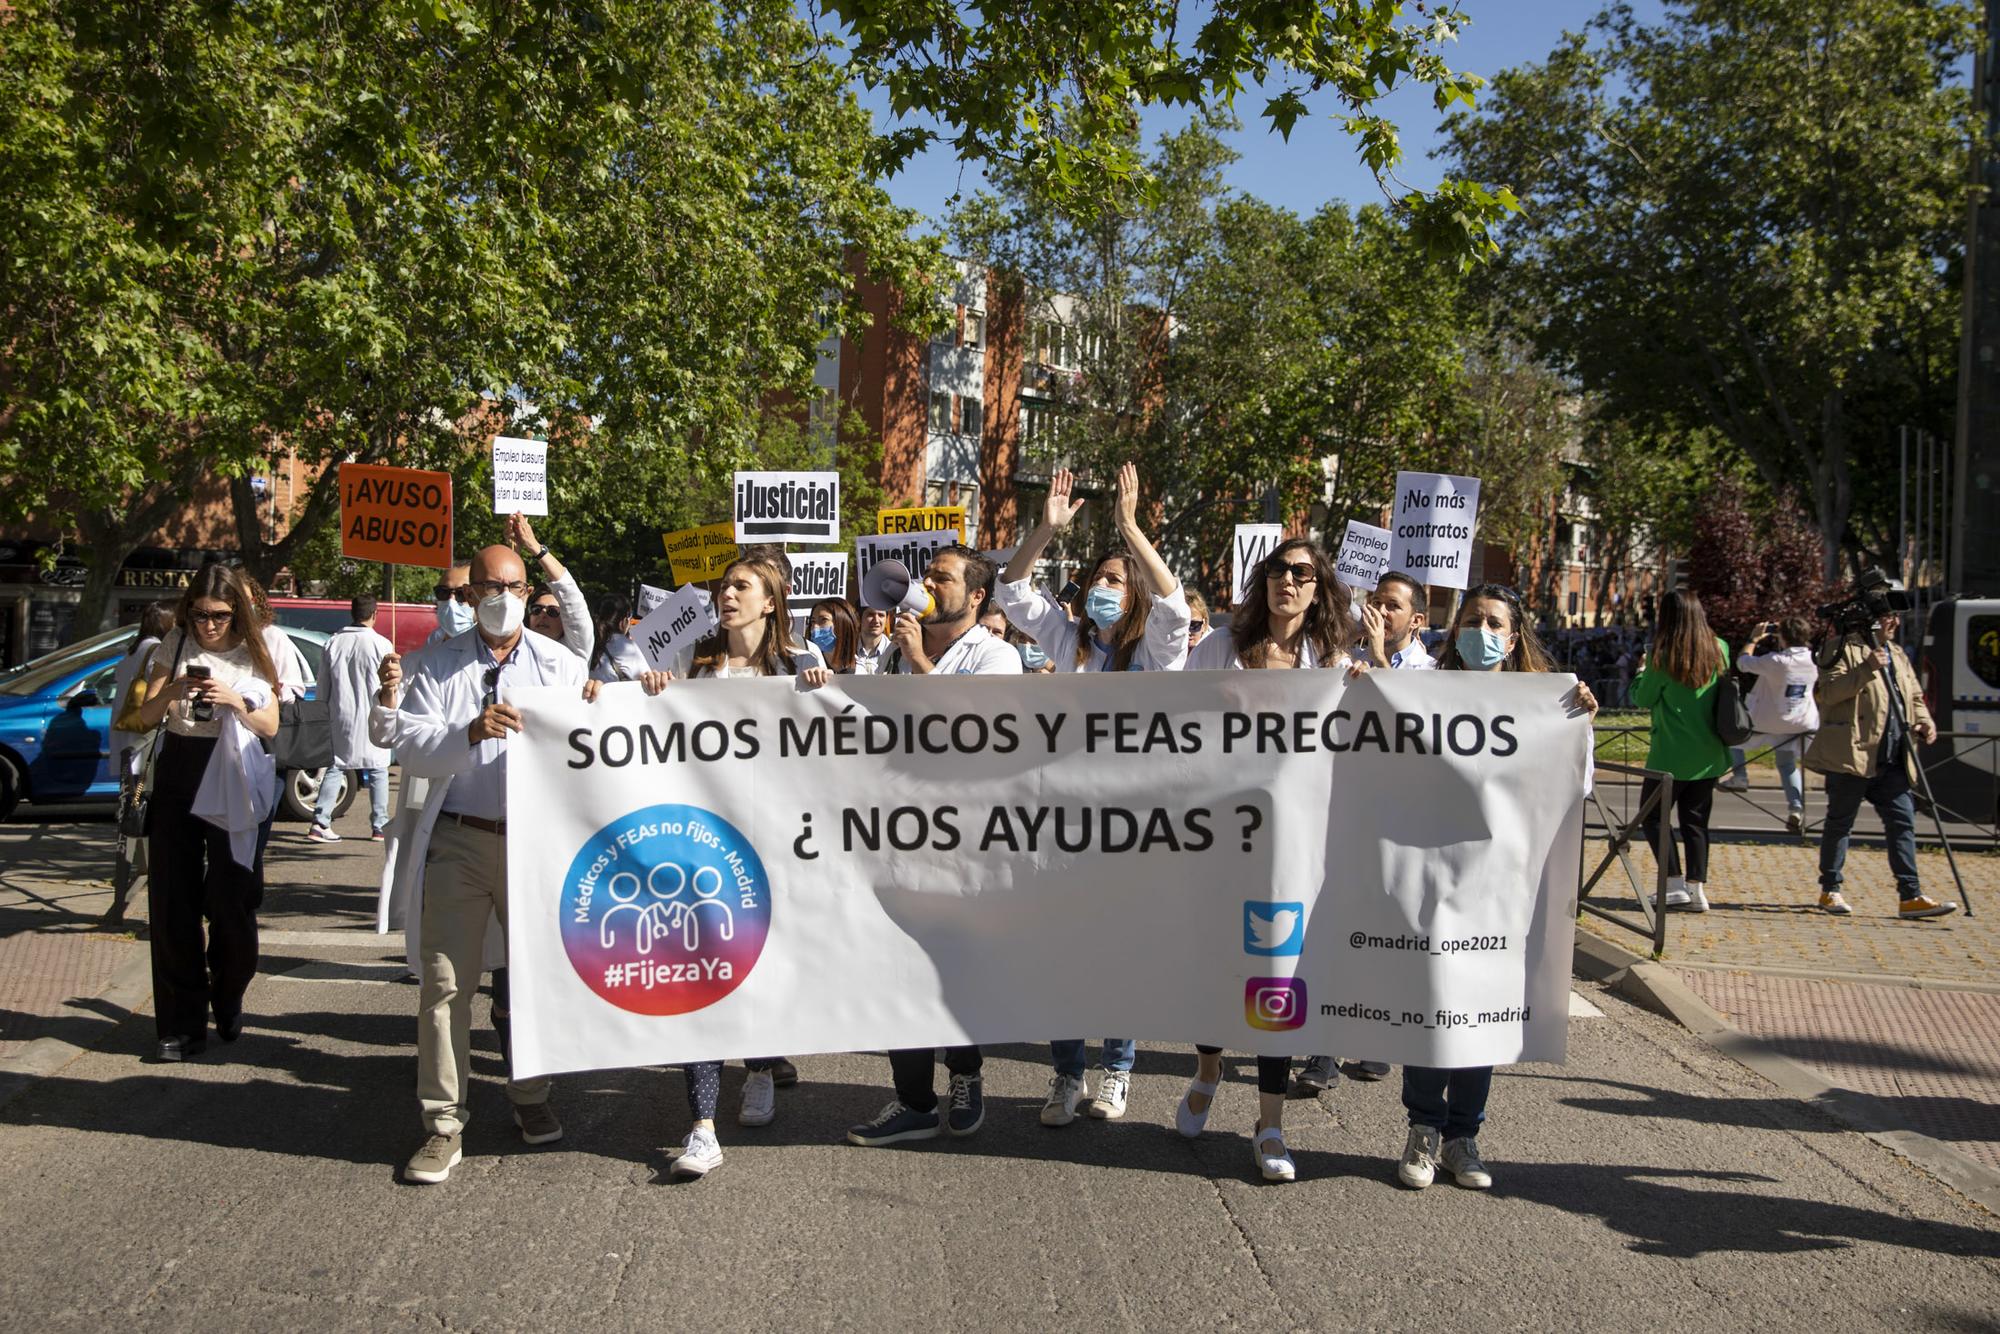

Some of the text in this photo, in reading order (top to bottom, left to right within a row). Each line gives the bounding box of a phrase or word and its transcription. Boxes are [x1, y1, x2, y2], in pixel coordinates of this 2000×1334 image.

[495, 448, 545, 465] Empleo basura
[346, 478, 448, 516] ¡AYUSO,
[522, 488, 545, 501] salud.
[737, 479, 836, 522] ¡Justicia!
[1402, 489, 1465, 514] ¡No más
[348, 515, 448, 548] ABUSO!
[883, 513, 960, 534] FRAUDE
[1398, 522, 1469, 539] contratos
[1347, 531, 1389, 550] Empleo
[1340, 547, 1348, 558] y
[1349, 550, 1377, 564] poco
[1406, 549, 1460, 569] basura!
[124, 570, 197, 587] RESTA
[790, 561, 845, 595] sticia!
[1337, 561, 1371, 579] dañan
[648, 606, 697, 662] ¡No más
[567, 704, 1519, 770] SOMOS MÉDICOS Y FEAs PRECARIOS
[842, 805, 961, 853] NOS
[979, 805, 1214, 854] AYUDAS
[574, 854, 609, 923] Médicos
[605, 844, 618, 861] y
[616, 822, 658, 850] FEAs
[661, 821, 683, 835] no
[685, 820, 721, 849] fijos
[723, 850, 758, 909] Madrid
[1349, 931, 1508, 955] @madrid_ope2021
[604, 957, 733, 989] #FijezaYa
[1320, 1003, 1531, 1029] medicos_no_fijos_madrid
